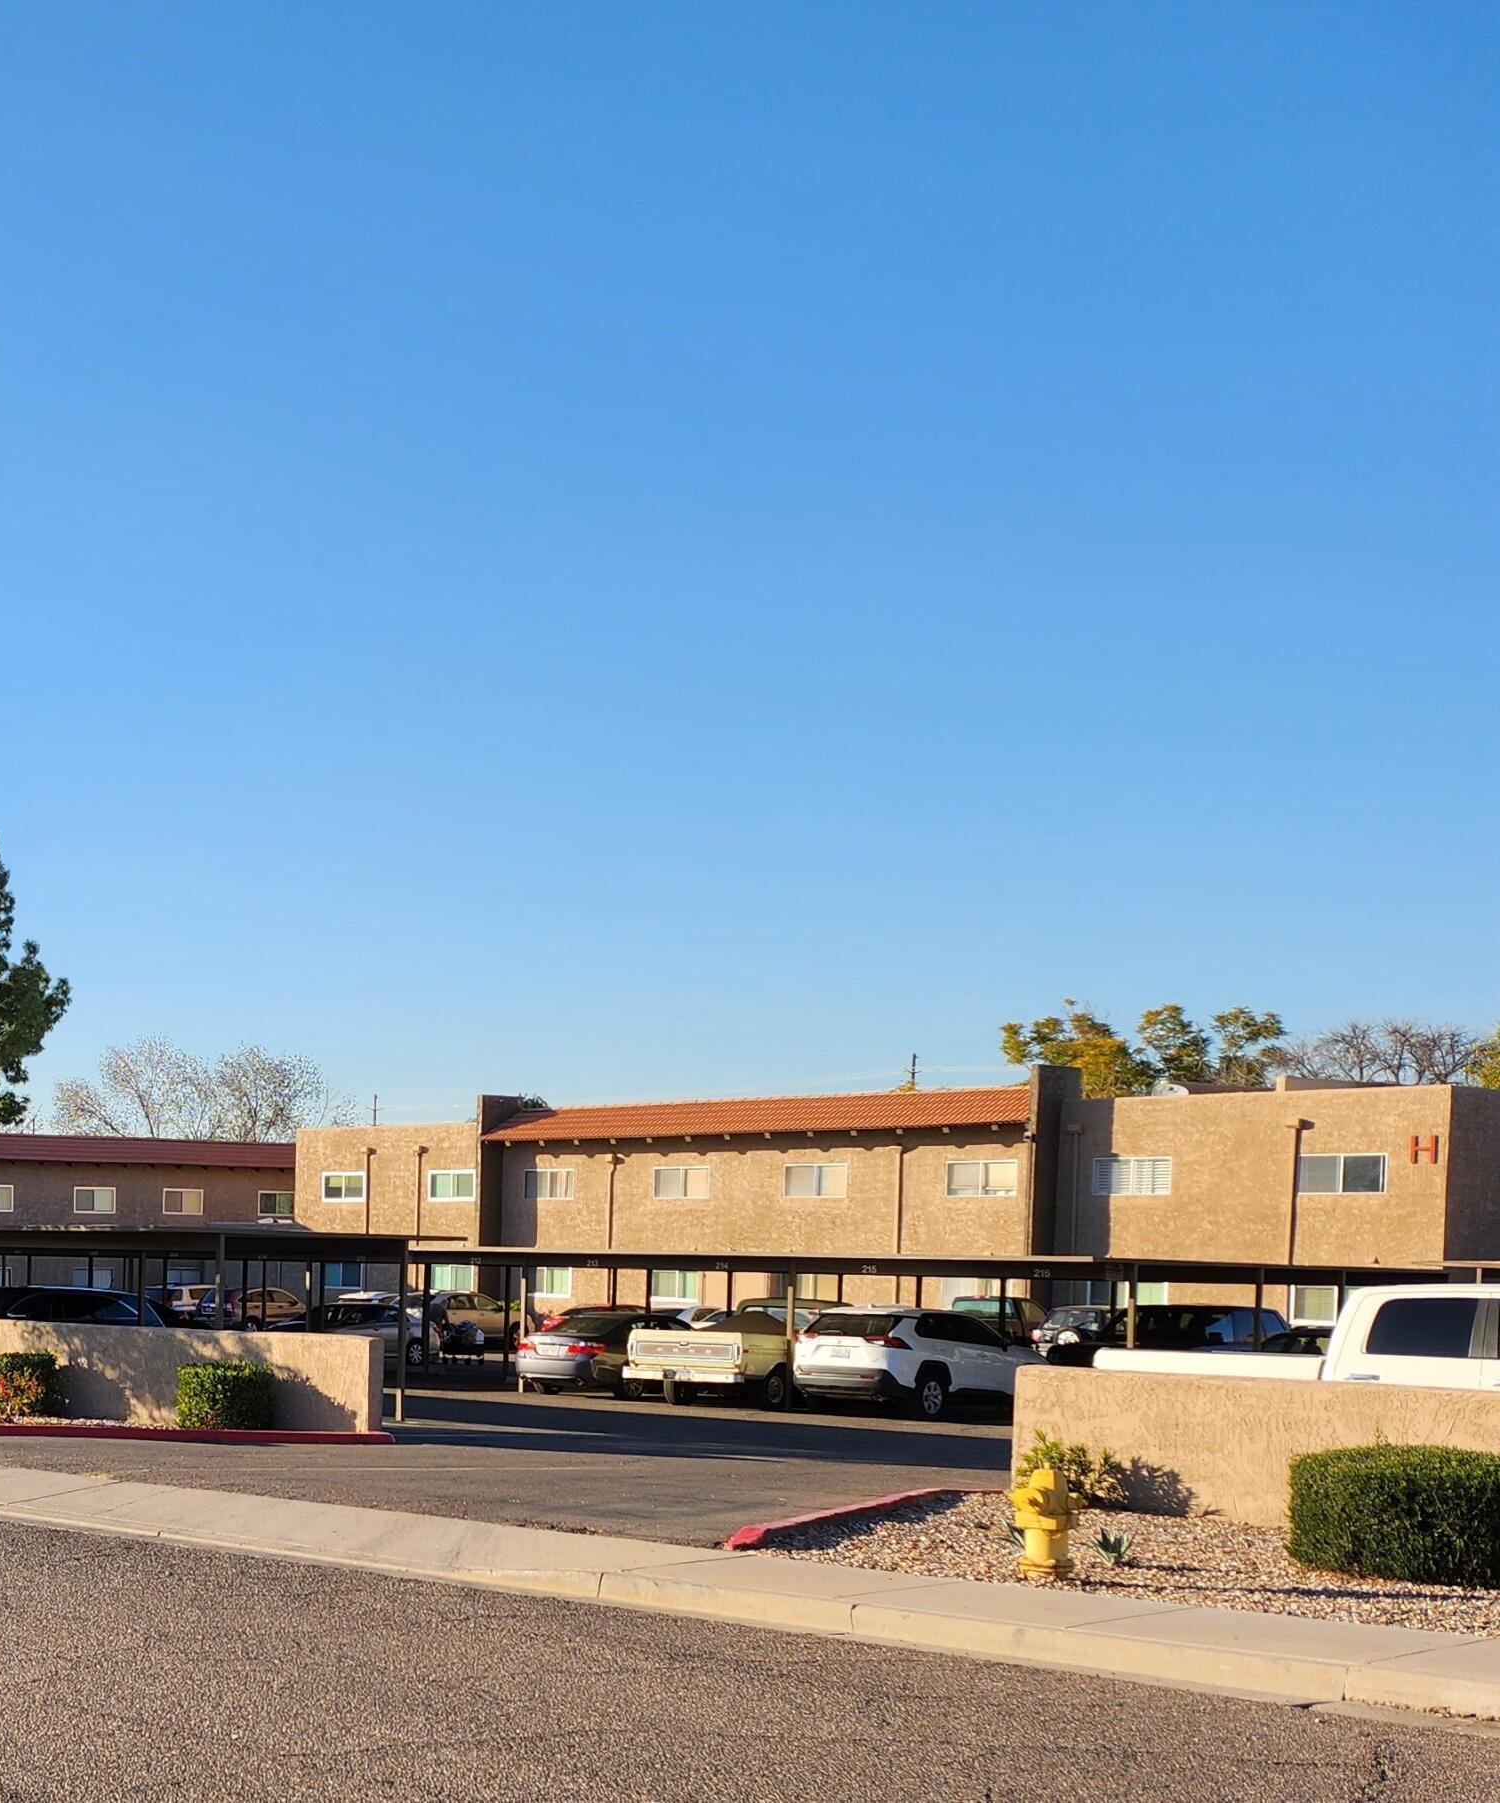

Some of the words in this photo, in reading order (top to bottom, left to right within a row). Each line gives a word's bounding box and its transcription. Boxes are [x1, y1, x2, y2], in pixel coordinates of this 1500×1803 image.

[1410, 1135, 1439, 1164] H
[586, 1259, 599, 1267] 213
[715, 1262, 729, 1270] 214
[861, 1265, 877, 1273] 215
[1033, 1269, 1052, 1278] 216
